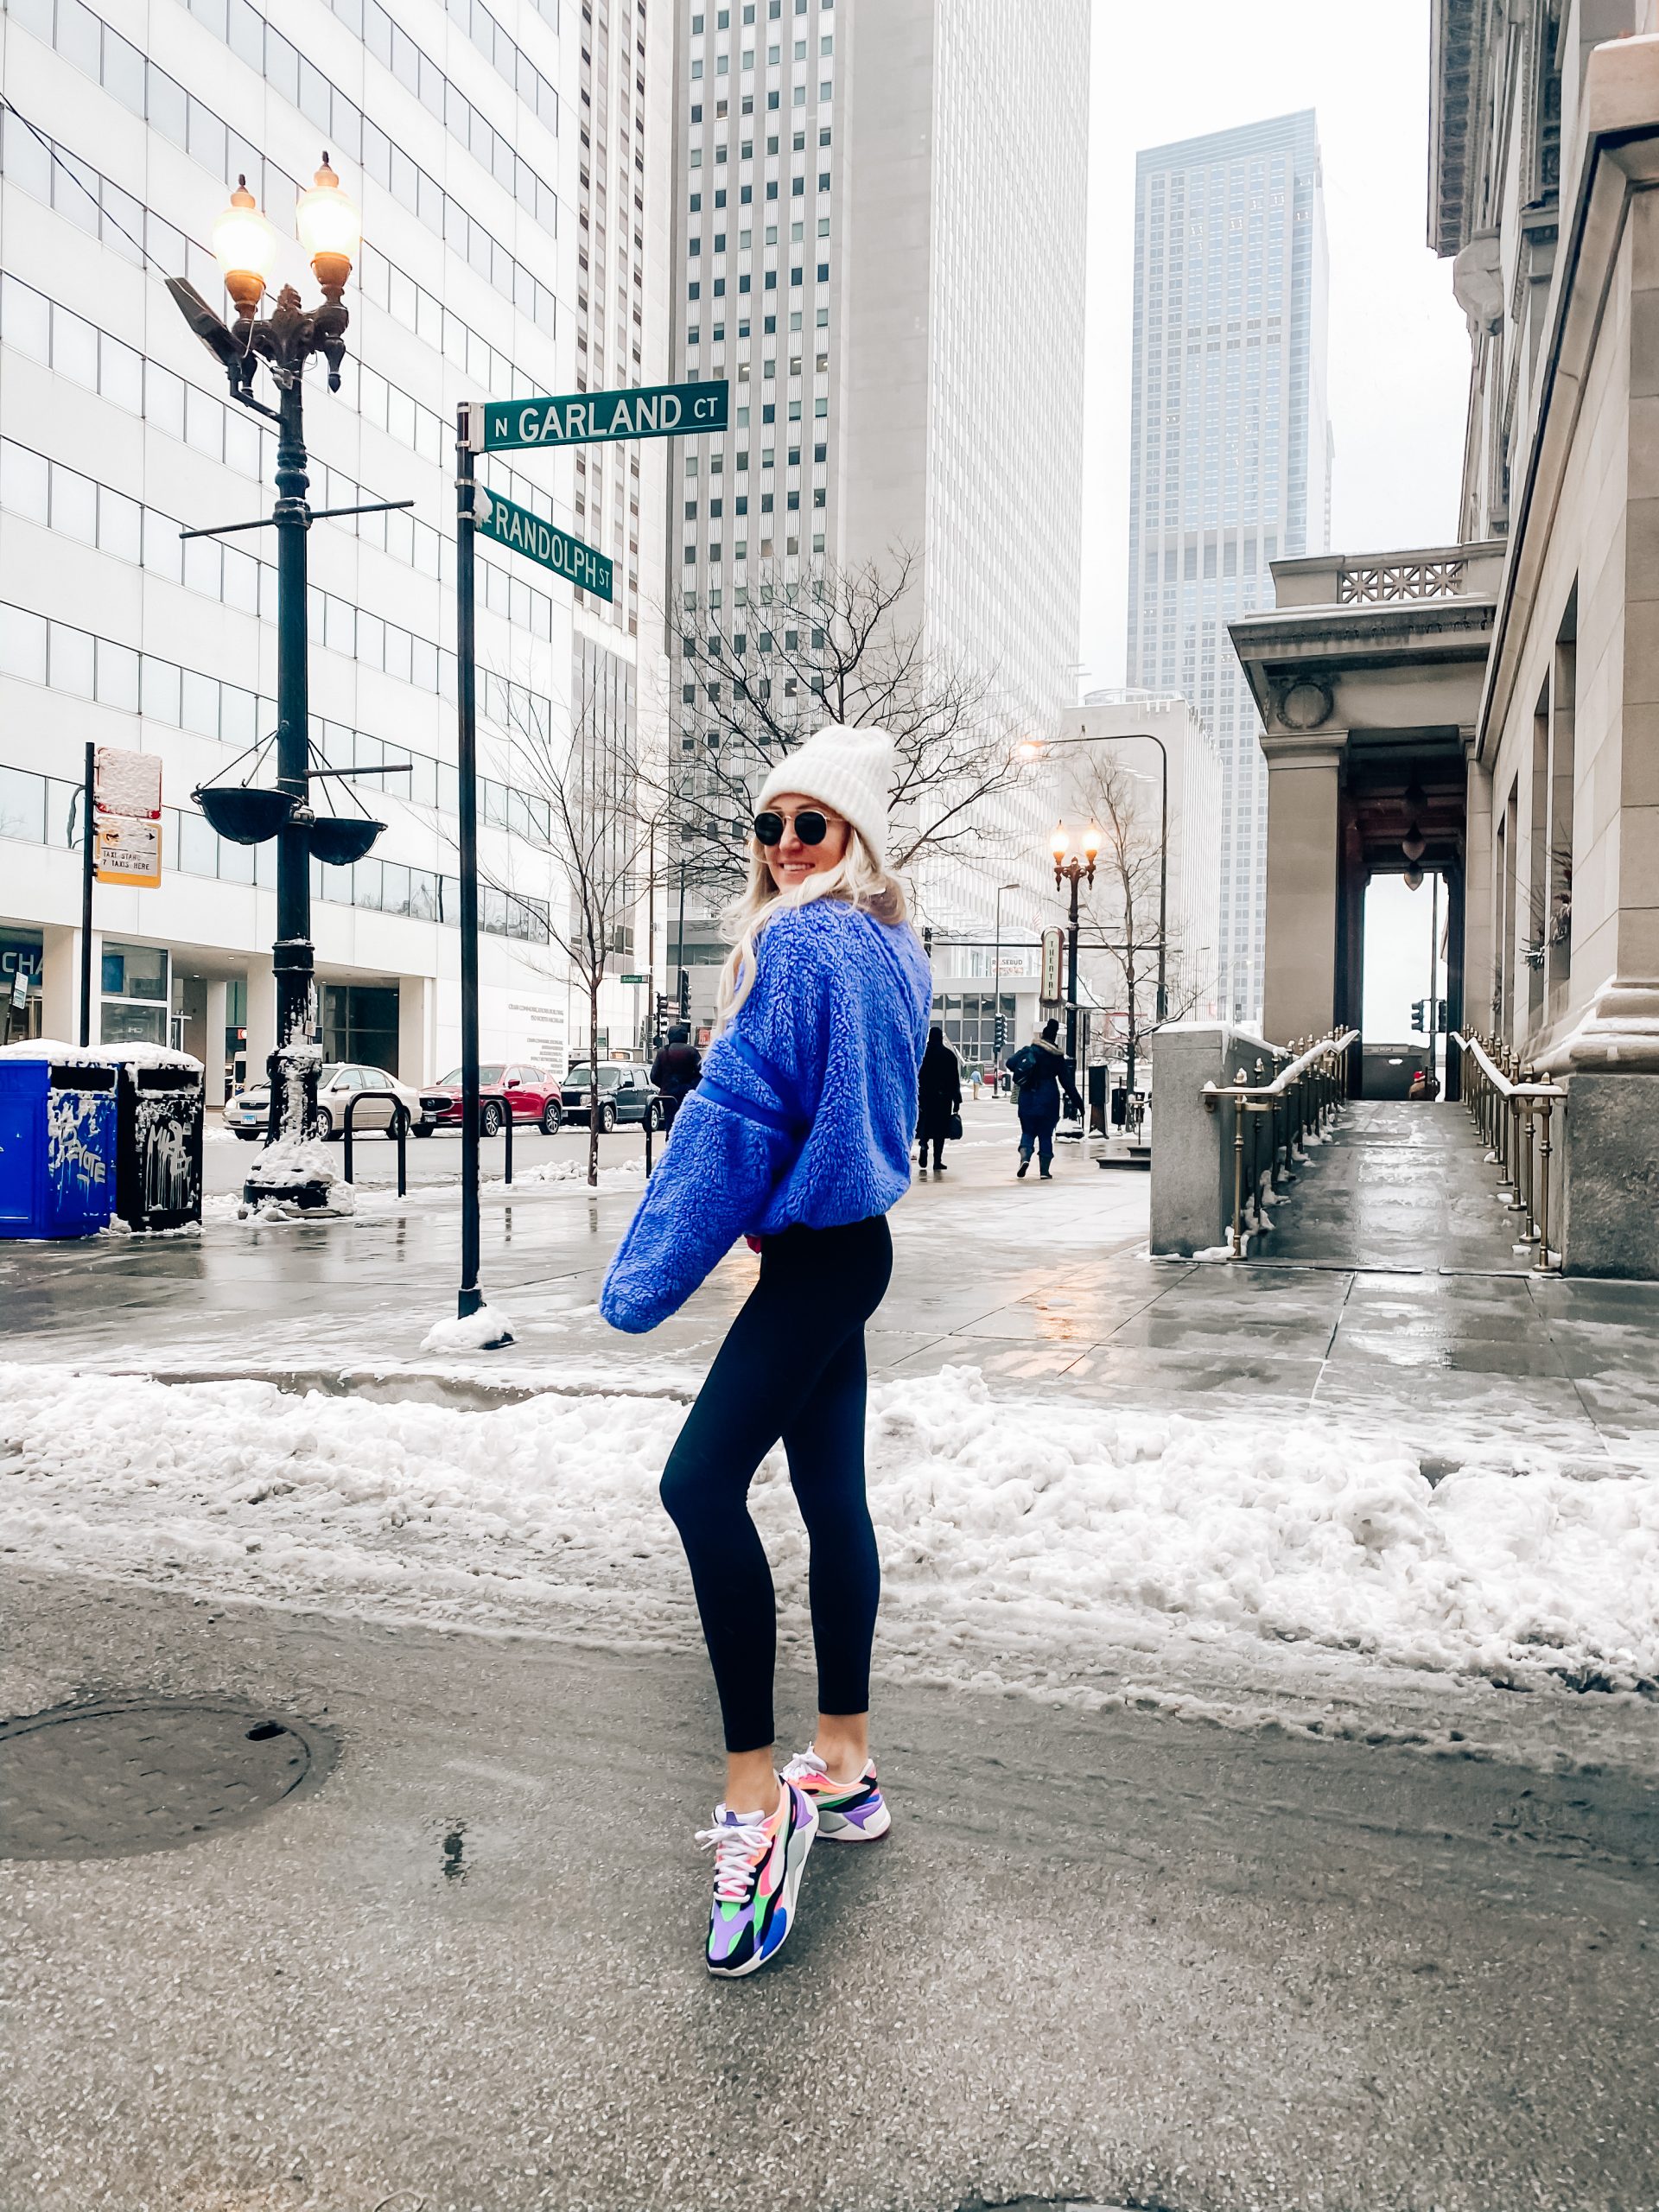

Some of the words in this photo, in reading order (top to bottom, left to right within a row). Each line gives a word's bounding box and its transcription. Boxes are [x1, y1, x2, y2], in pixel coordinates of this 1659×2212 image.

[495, 417, 508, 437] N
[518, 395, 682, 442] GARLAND
[694, 397, 719, 419] CT
[496, 501, 596, 588] RANDOLPH
[599, 568, 610, 588] ST
[103, 850, 117, 859] TAXI
[111, 860, 130, 868] TAXIS
[133, 862, 150, 871] HERE
